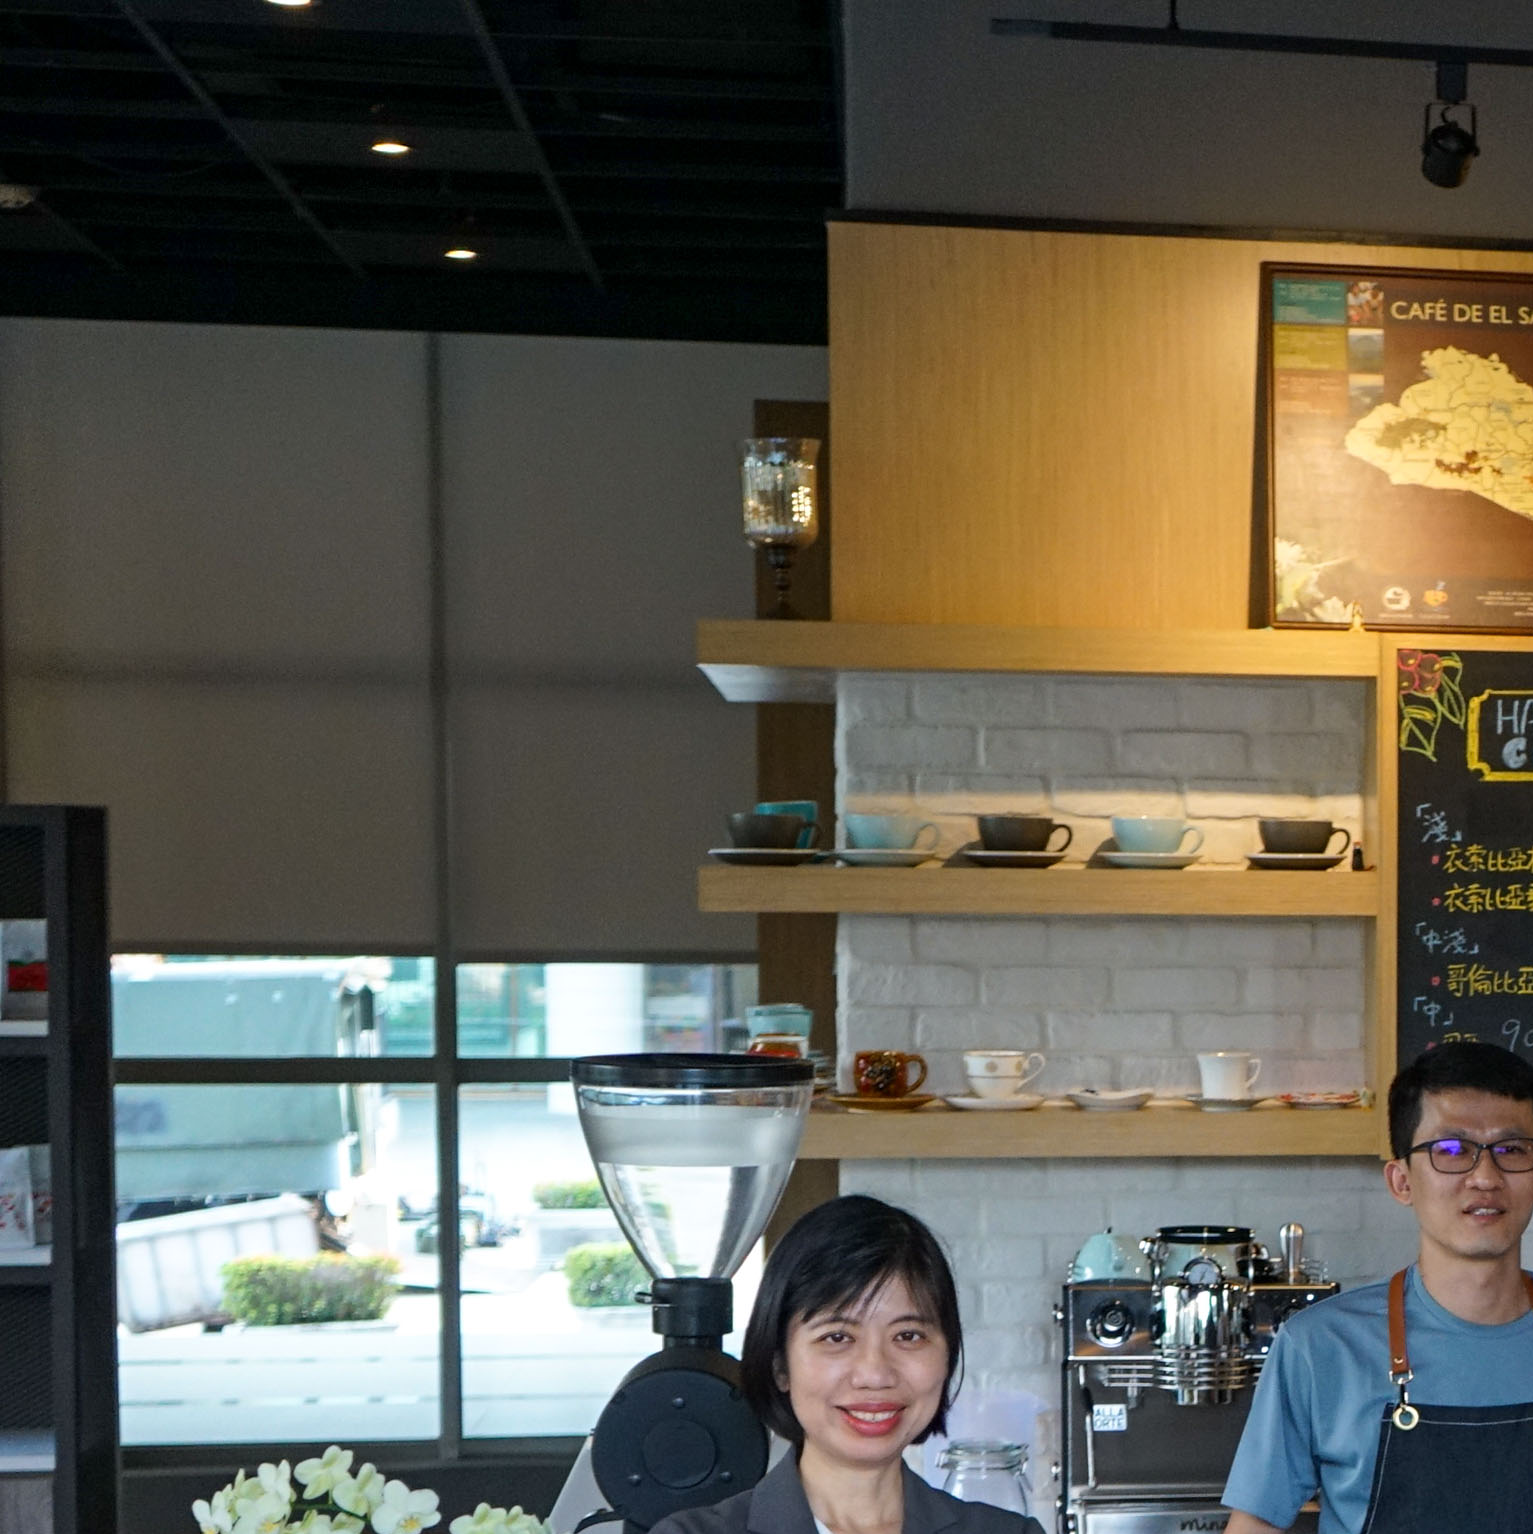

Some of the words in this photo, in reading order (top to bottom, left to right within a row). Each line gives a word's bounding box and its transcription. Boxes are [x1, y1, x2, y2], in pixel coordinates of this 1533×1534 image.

[1390, 299, 1448, 323] CAFÉ
[1452, 305, 1485, 323] DE
[1488, 306, 1514, 325] EL
